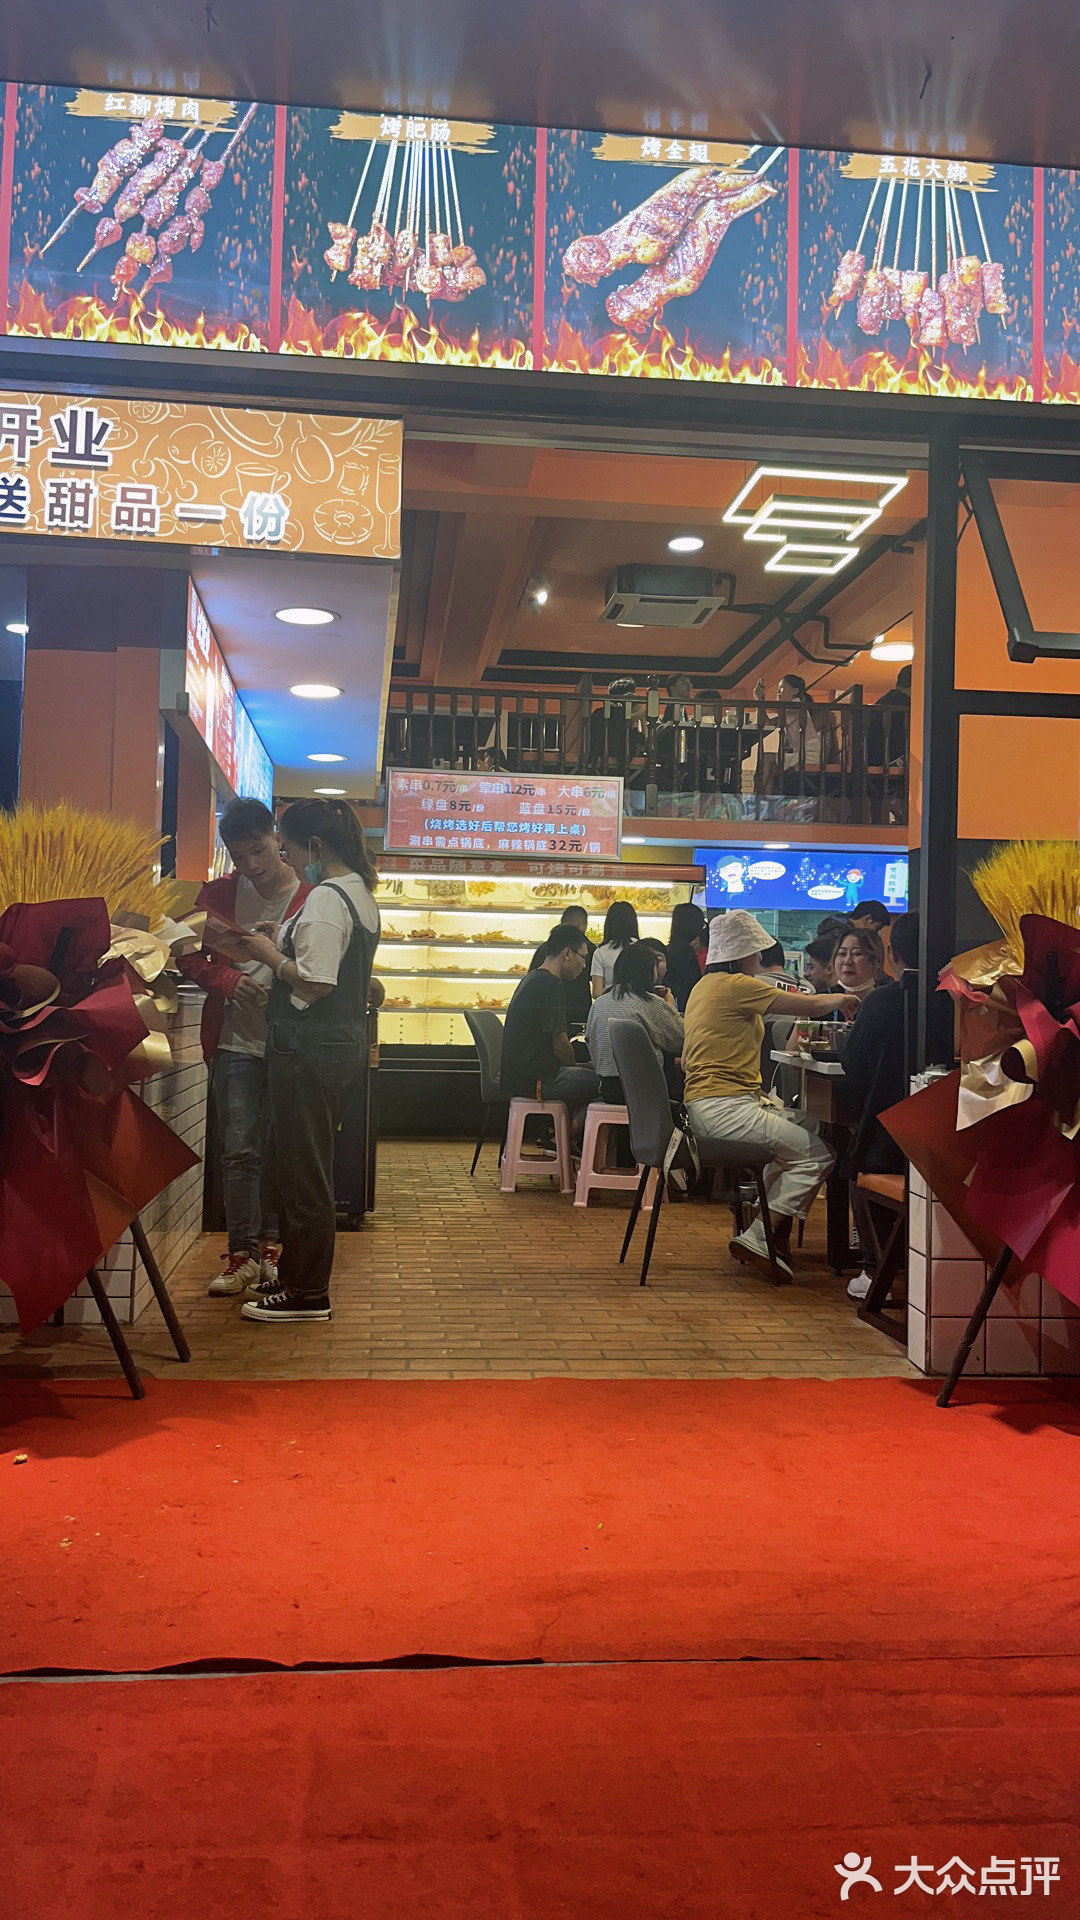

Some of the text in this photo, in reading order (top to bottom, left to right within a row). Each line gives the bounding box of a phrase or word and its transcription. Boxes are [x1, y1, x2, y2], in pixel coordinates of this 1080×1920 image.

[104, 92, 199, 119] 红柳烤肉
[380, 117, 450, 142] 烤肥肠
[640, 136, 710, 163] 烤全翅
[879, 157, 967, 182] 五花大绑
